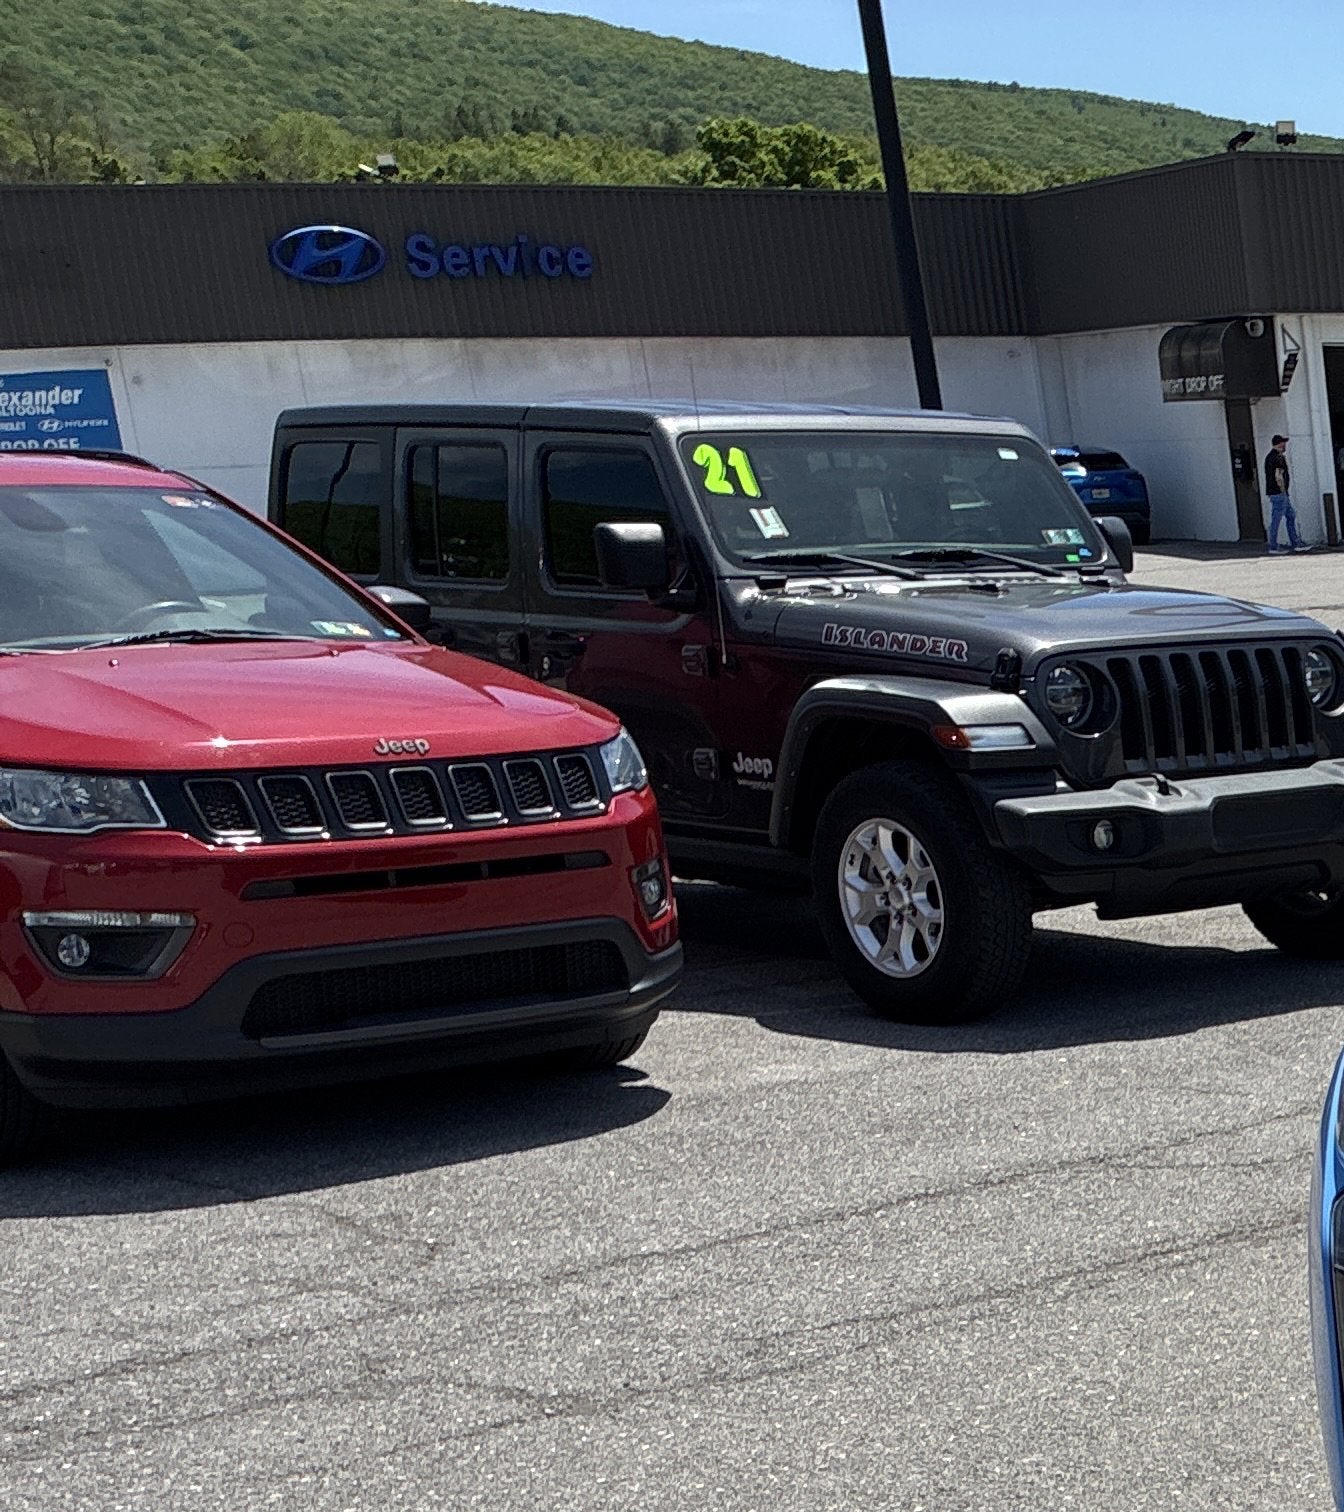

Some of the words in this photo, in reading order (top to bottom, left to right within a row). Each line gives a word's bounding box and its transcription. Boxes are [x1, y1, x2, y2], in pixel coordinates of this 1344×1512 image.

[405, 232, 593, 278] Service
[0, 385, 84, 406] exander
[692, 443, 761, 499] 21
[821, 622, 968, 663] ISLANDER
[374, 737, 431, 756] Jeep
[732, 751, 773, 779] Jeep
